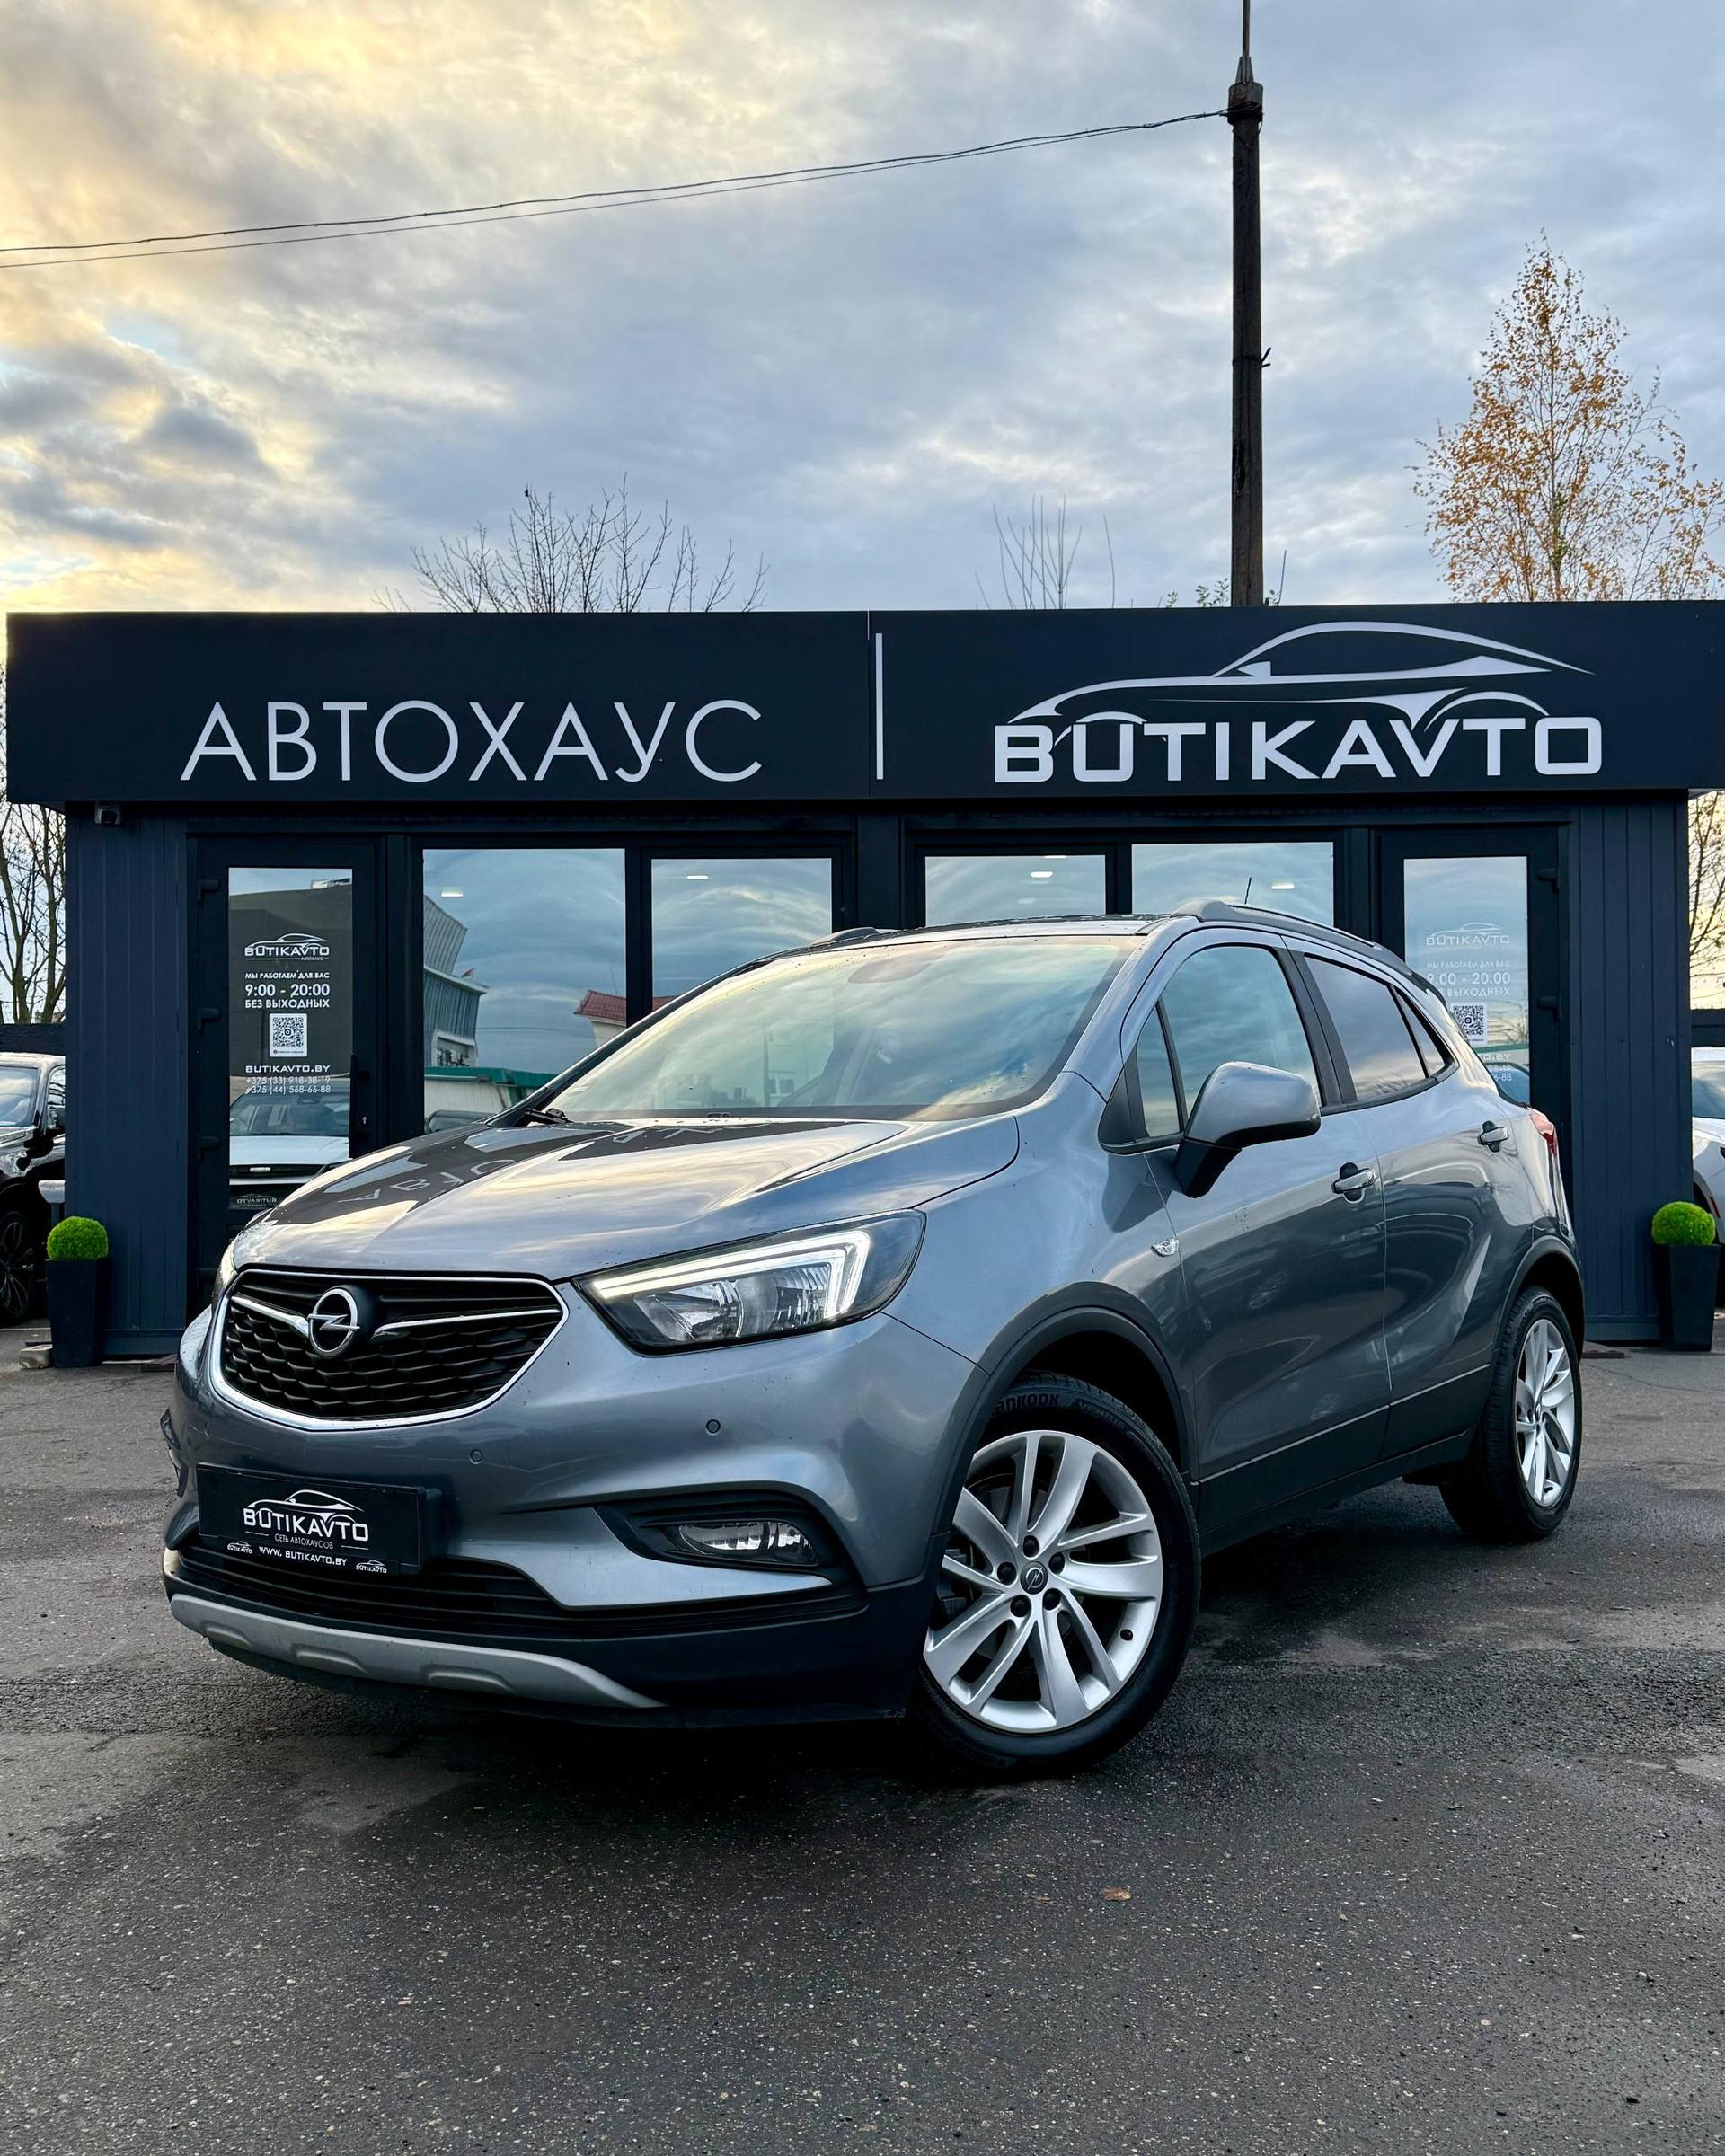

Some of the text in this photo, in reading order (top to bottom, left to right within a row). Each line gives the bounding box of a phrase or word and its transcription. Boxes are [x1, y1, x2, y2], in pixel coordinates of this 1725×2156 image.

[180, 699, 763, 783] АВТОХАУС
[995, 716, 1603, 783] BUTIKAVTO
[1426, 934, 1510, 946] BUTIKAVTO
[244, 946, 330, 956] BUTIKAVTO
[1427, 973, 1456, 985] 9:00
[1473, 972, 1510, 985] 20:00
[245, 984, 276, 996] 9:00
[290, 984, 331, 996] 20:00
[1447, 987, 1510, 997] ВЫХОДНЫХ
[244, 999, 331, 1009] БЕЗ ВЫХОДНЫХ
[245, 1076, 331, 1086] +375 (33) 918-38-19
[245, 1085, 331, 1095] +375 (44) 568-66-88
[243, 1507, 369, 1542] BUTIKAVTO
[274, 1533, 334, 1550] СЕТЬ АВТОХАУСОВ
[259, 1546, 348, 1566] WWW. BUTIKAVTO.BY
